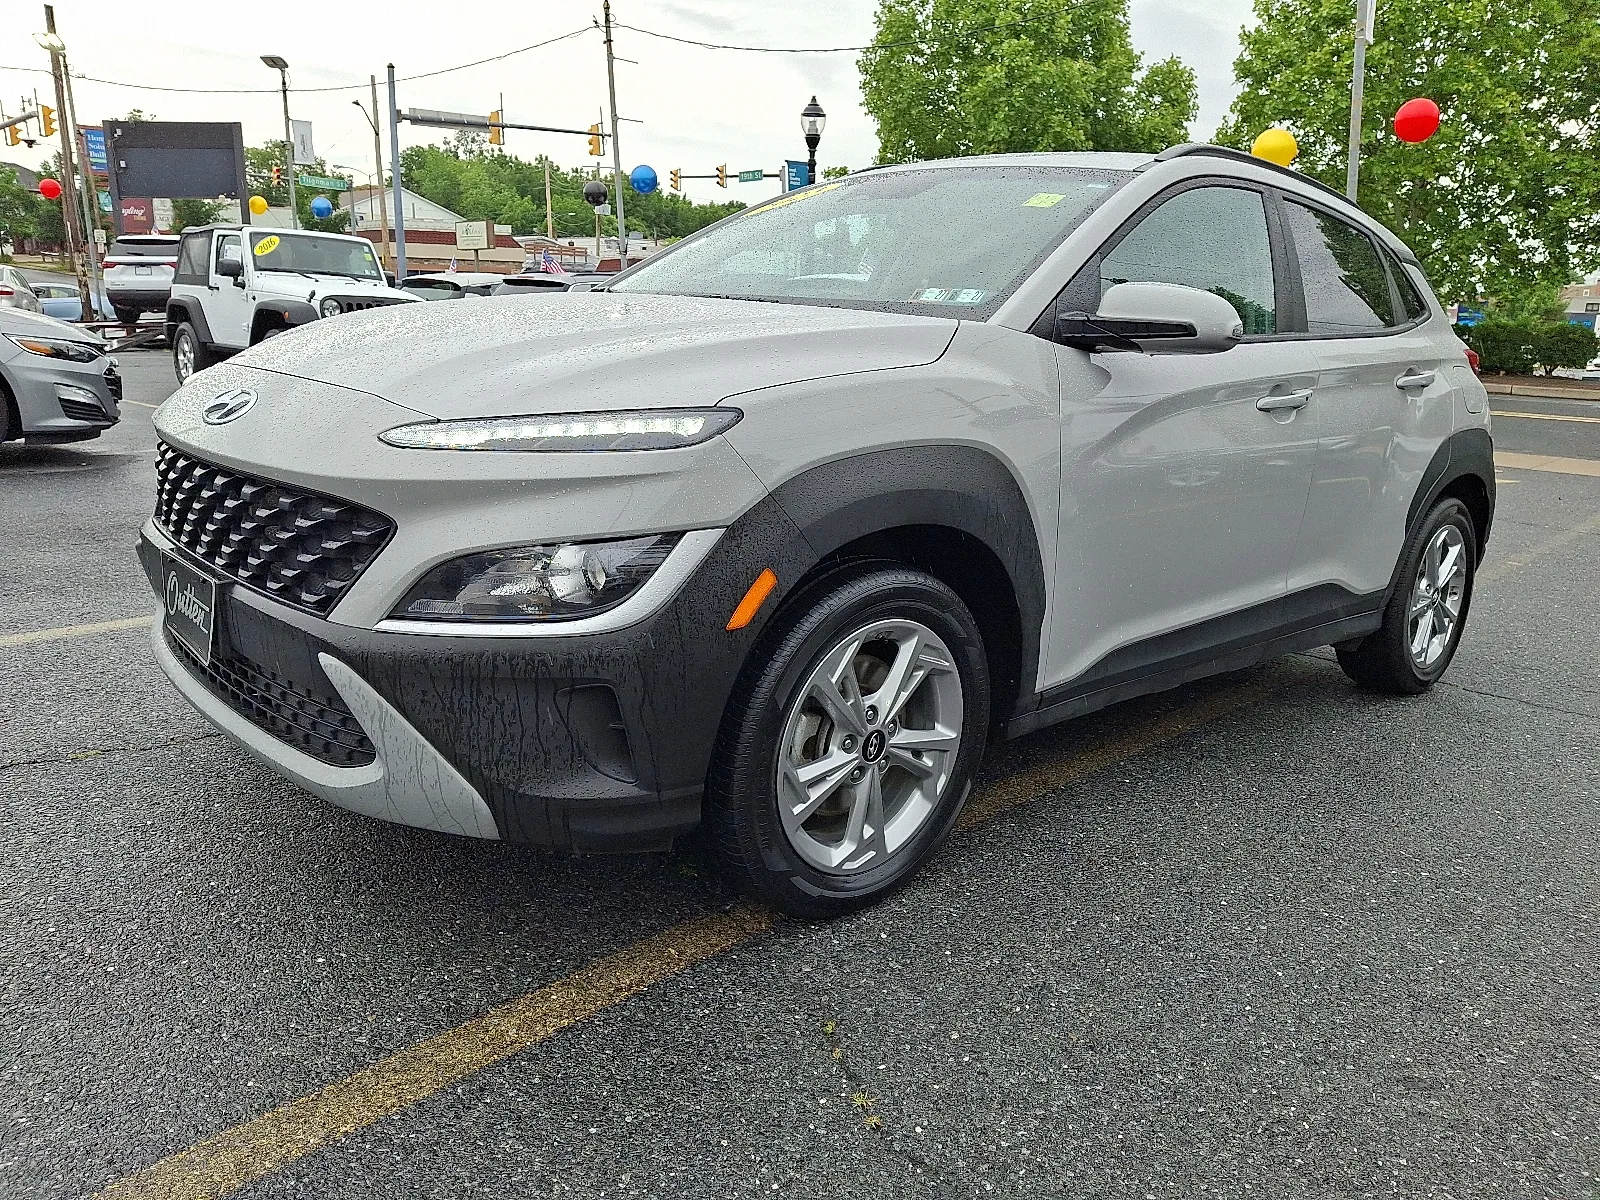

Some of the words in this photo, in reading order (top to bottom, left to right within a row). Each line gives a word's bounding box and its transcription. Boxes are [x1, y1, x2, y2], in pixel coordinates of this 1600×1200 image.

[740, 172, 753, 180] 19th
[754, 171, 762, 179] St
[336, 180, 345, 188] St
[258, 237, 276, 254] 2016
[166, 570, 210, 634] Outten
